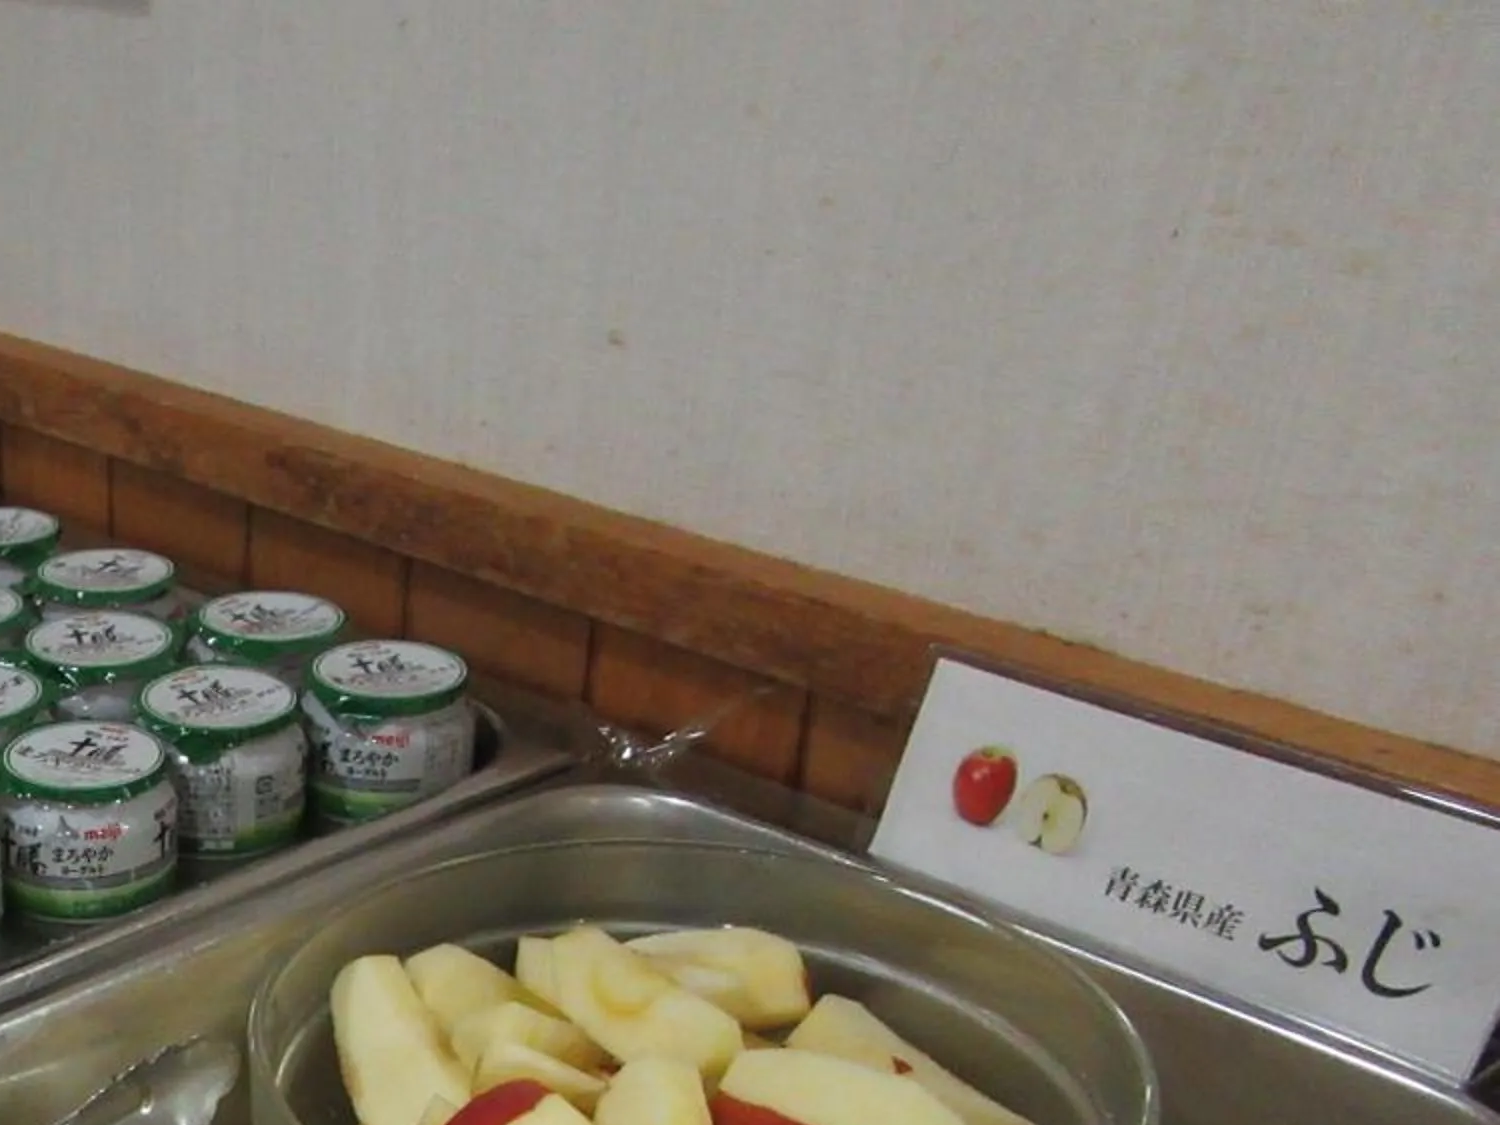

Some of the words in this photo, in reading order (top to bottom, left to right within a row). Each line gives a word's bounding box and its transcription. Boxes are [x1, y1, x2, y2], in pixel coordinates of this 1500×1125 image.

[1103, 865, 1246, 942] 青森県産
[1258, 885, 1443, 998] ふじ
